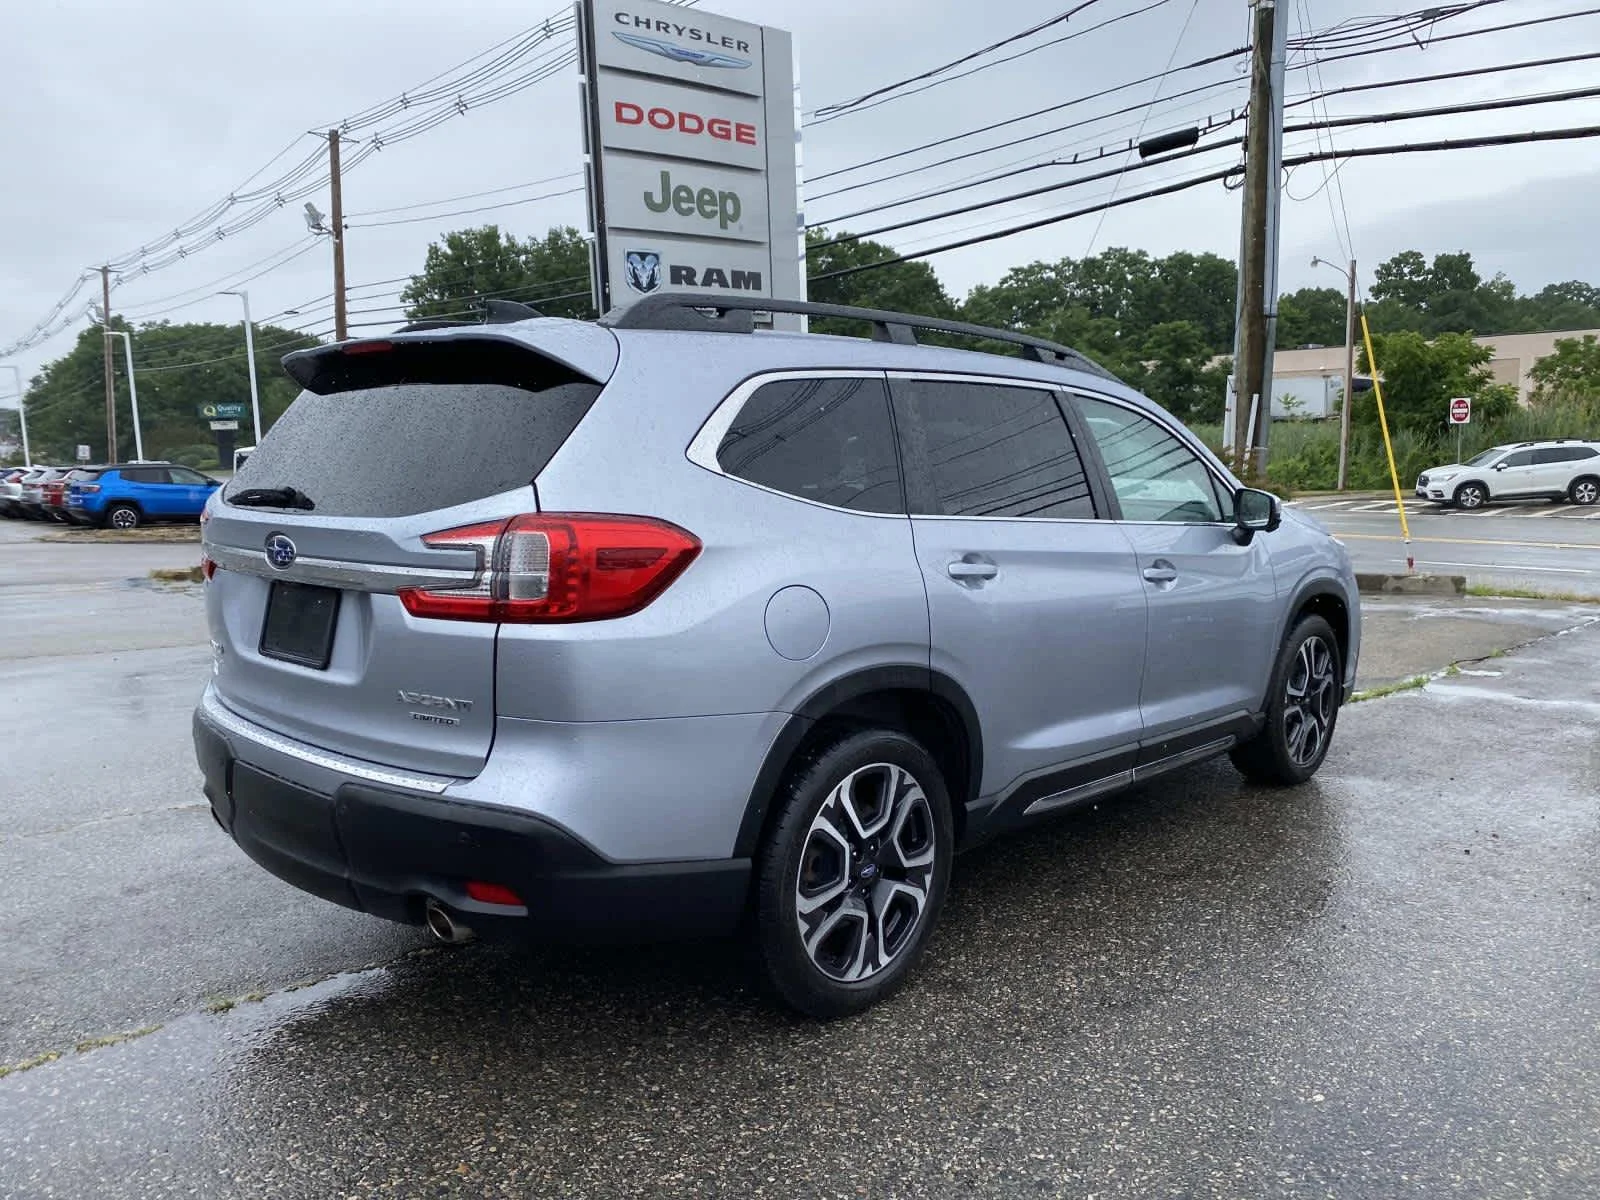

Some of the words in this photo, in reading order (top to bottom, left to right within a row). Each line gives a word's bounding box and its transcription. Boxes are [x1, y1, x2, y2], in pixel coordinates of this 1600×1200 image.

[614, 12, 750, 53] CHRYSLER
[614, 101, 757, 145] DODGE
[643, 170, 742, 230] Jeep
[669, 264, 762, 290] RAM
[410, 712, 460, 726] LIMITED
